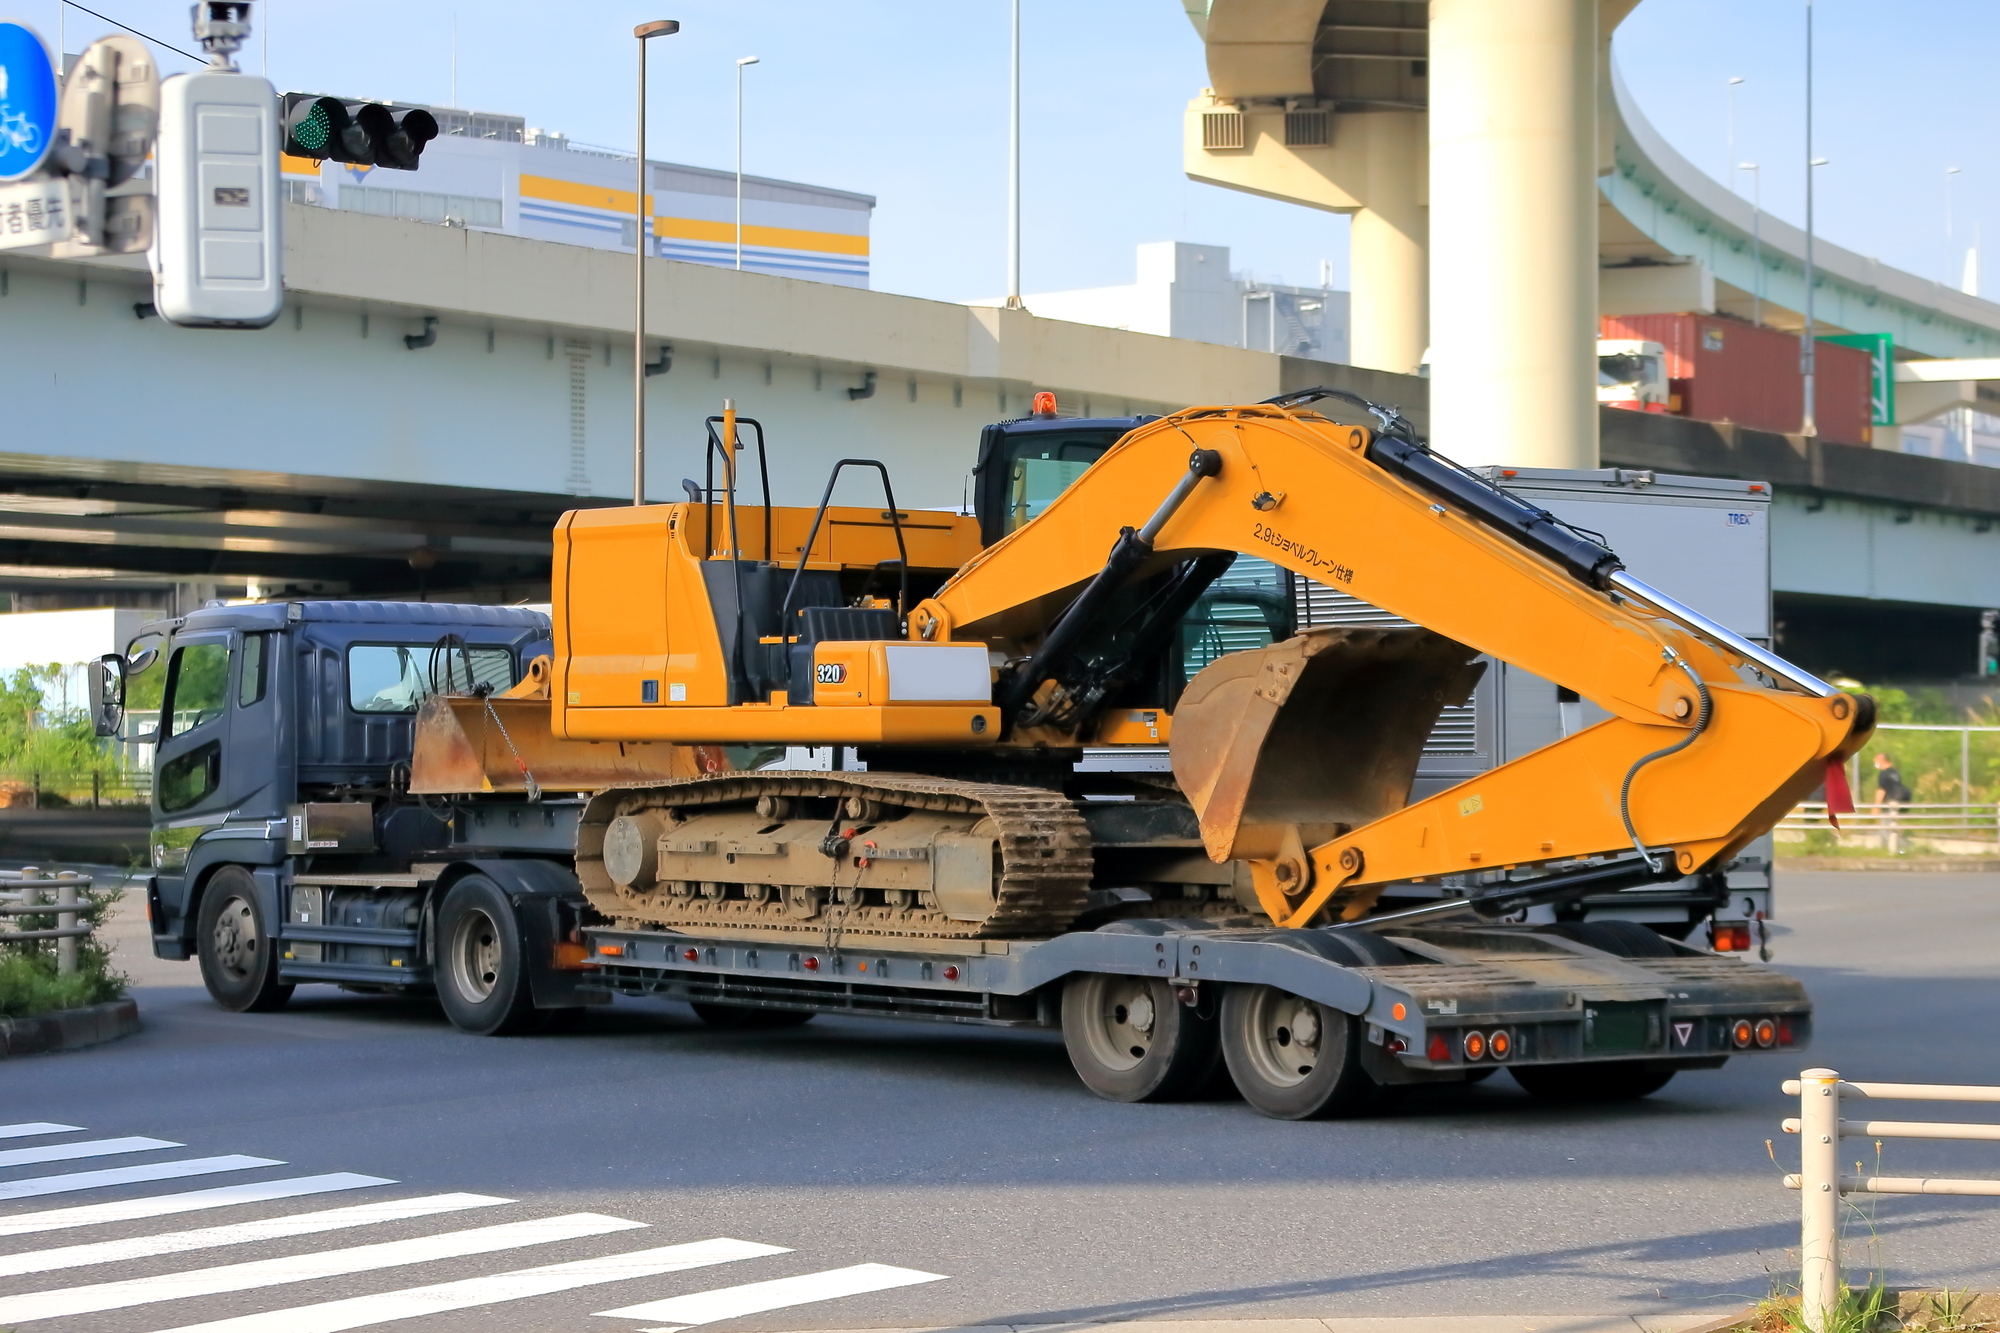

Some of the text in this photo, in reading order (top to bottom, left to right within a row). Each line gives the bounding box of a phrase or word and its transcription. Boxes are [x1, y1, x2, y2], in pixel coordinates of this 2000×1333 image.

[0, 198, 64, 234] 者優先
[1728, 513, 1751, 525] TREX
[1253, 523, 1354, 584] 2.9tショベルクレーン仕様
[817, 664, 840, 683] 320
